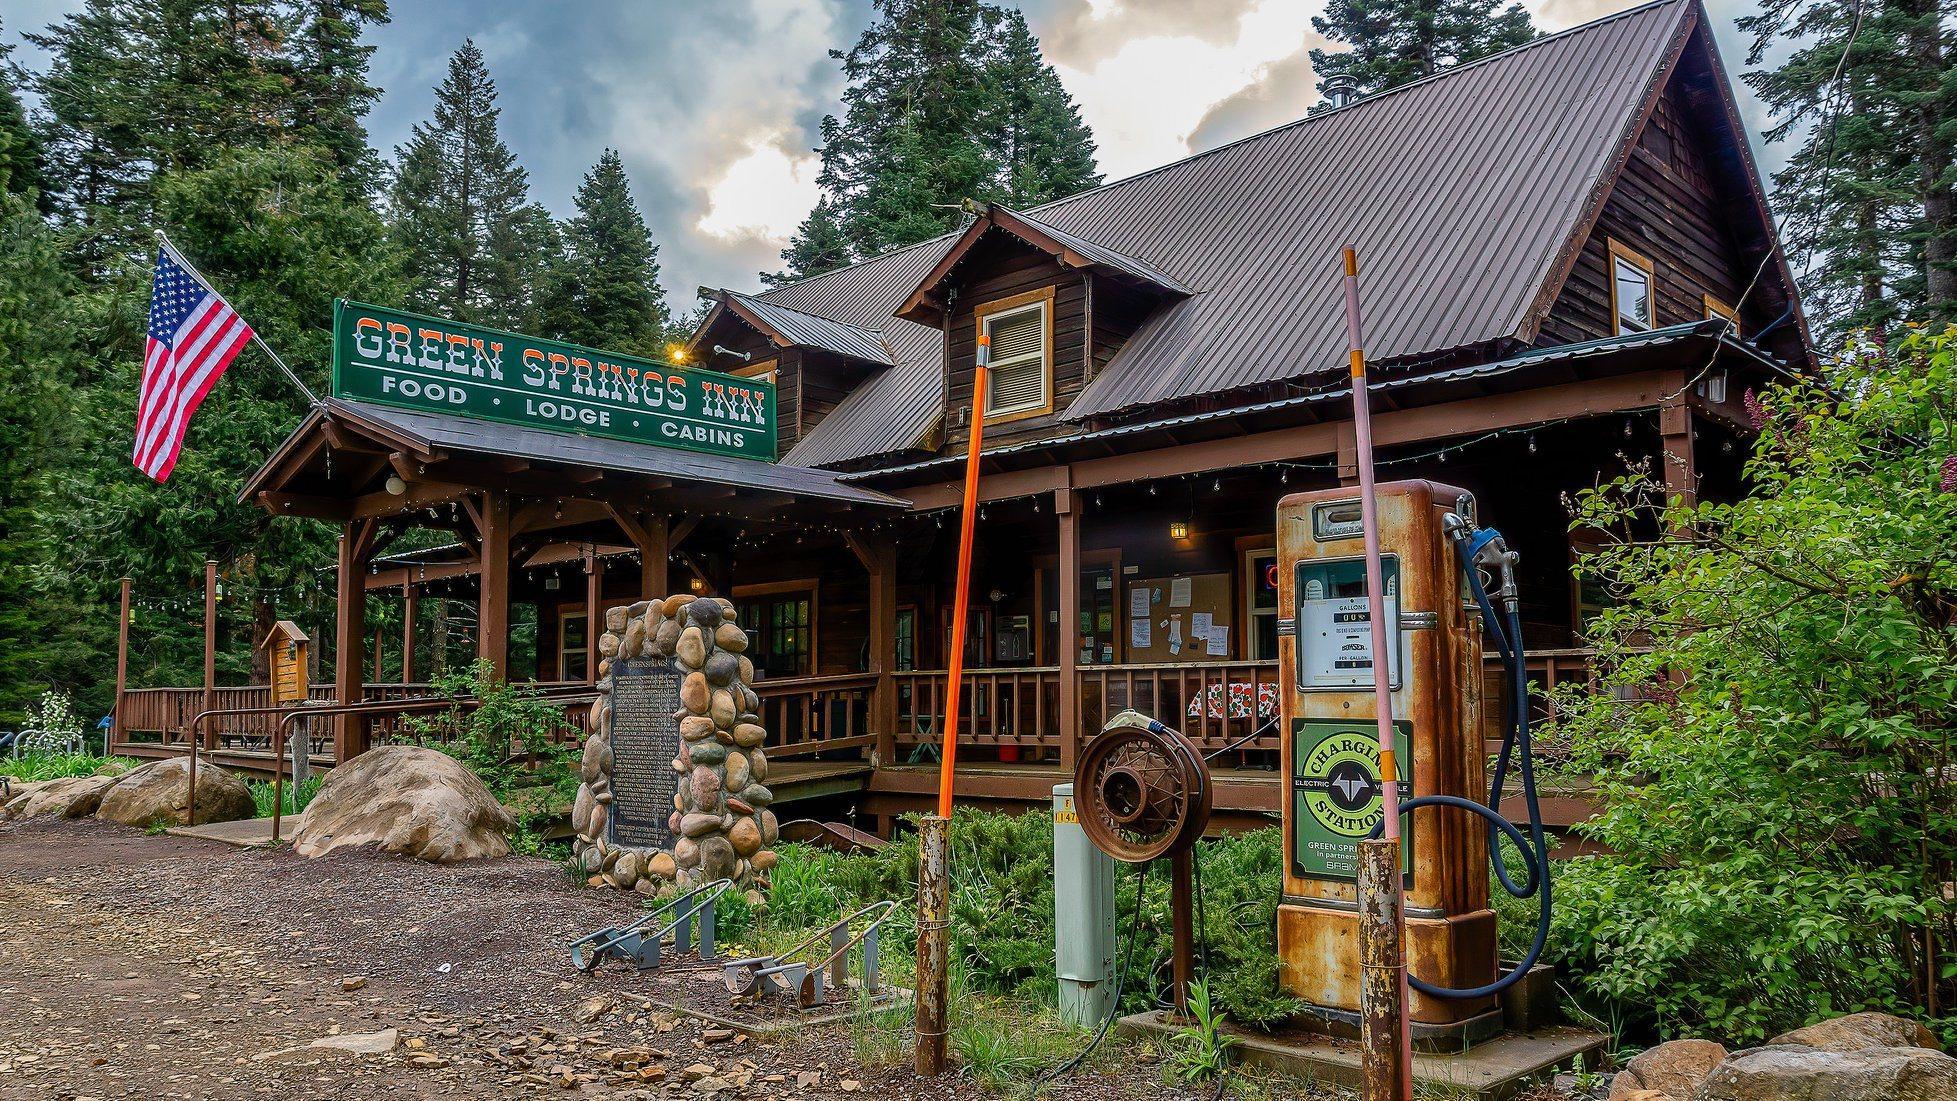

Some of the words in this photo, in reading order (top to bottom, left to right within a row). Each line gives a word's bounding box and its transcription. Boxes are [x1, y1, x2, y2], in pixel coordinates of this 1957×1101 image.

[352, 316, 504, 380] GREEN
[521, 347, 687, 411] SPRINGS
[701, 380, 766, 426] INN
[382, 375, 468, 405] FOOD
[526, 398, 611, 428] LODGE
[660, 420, 745, 449] CABINS
[1311, 739, 1382, 774] CHARGIN
[1295, 780, 1330, 788] ELECTRIC
[1308, 841, 1336, 851] GREEN
[1338, 844, 1358, 853] SPRI
